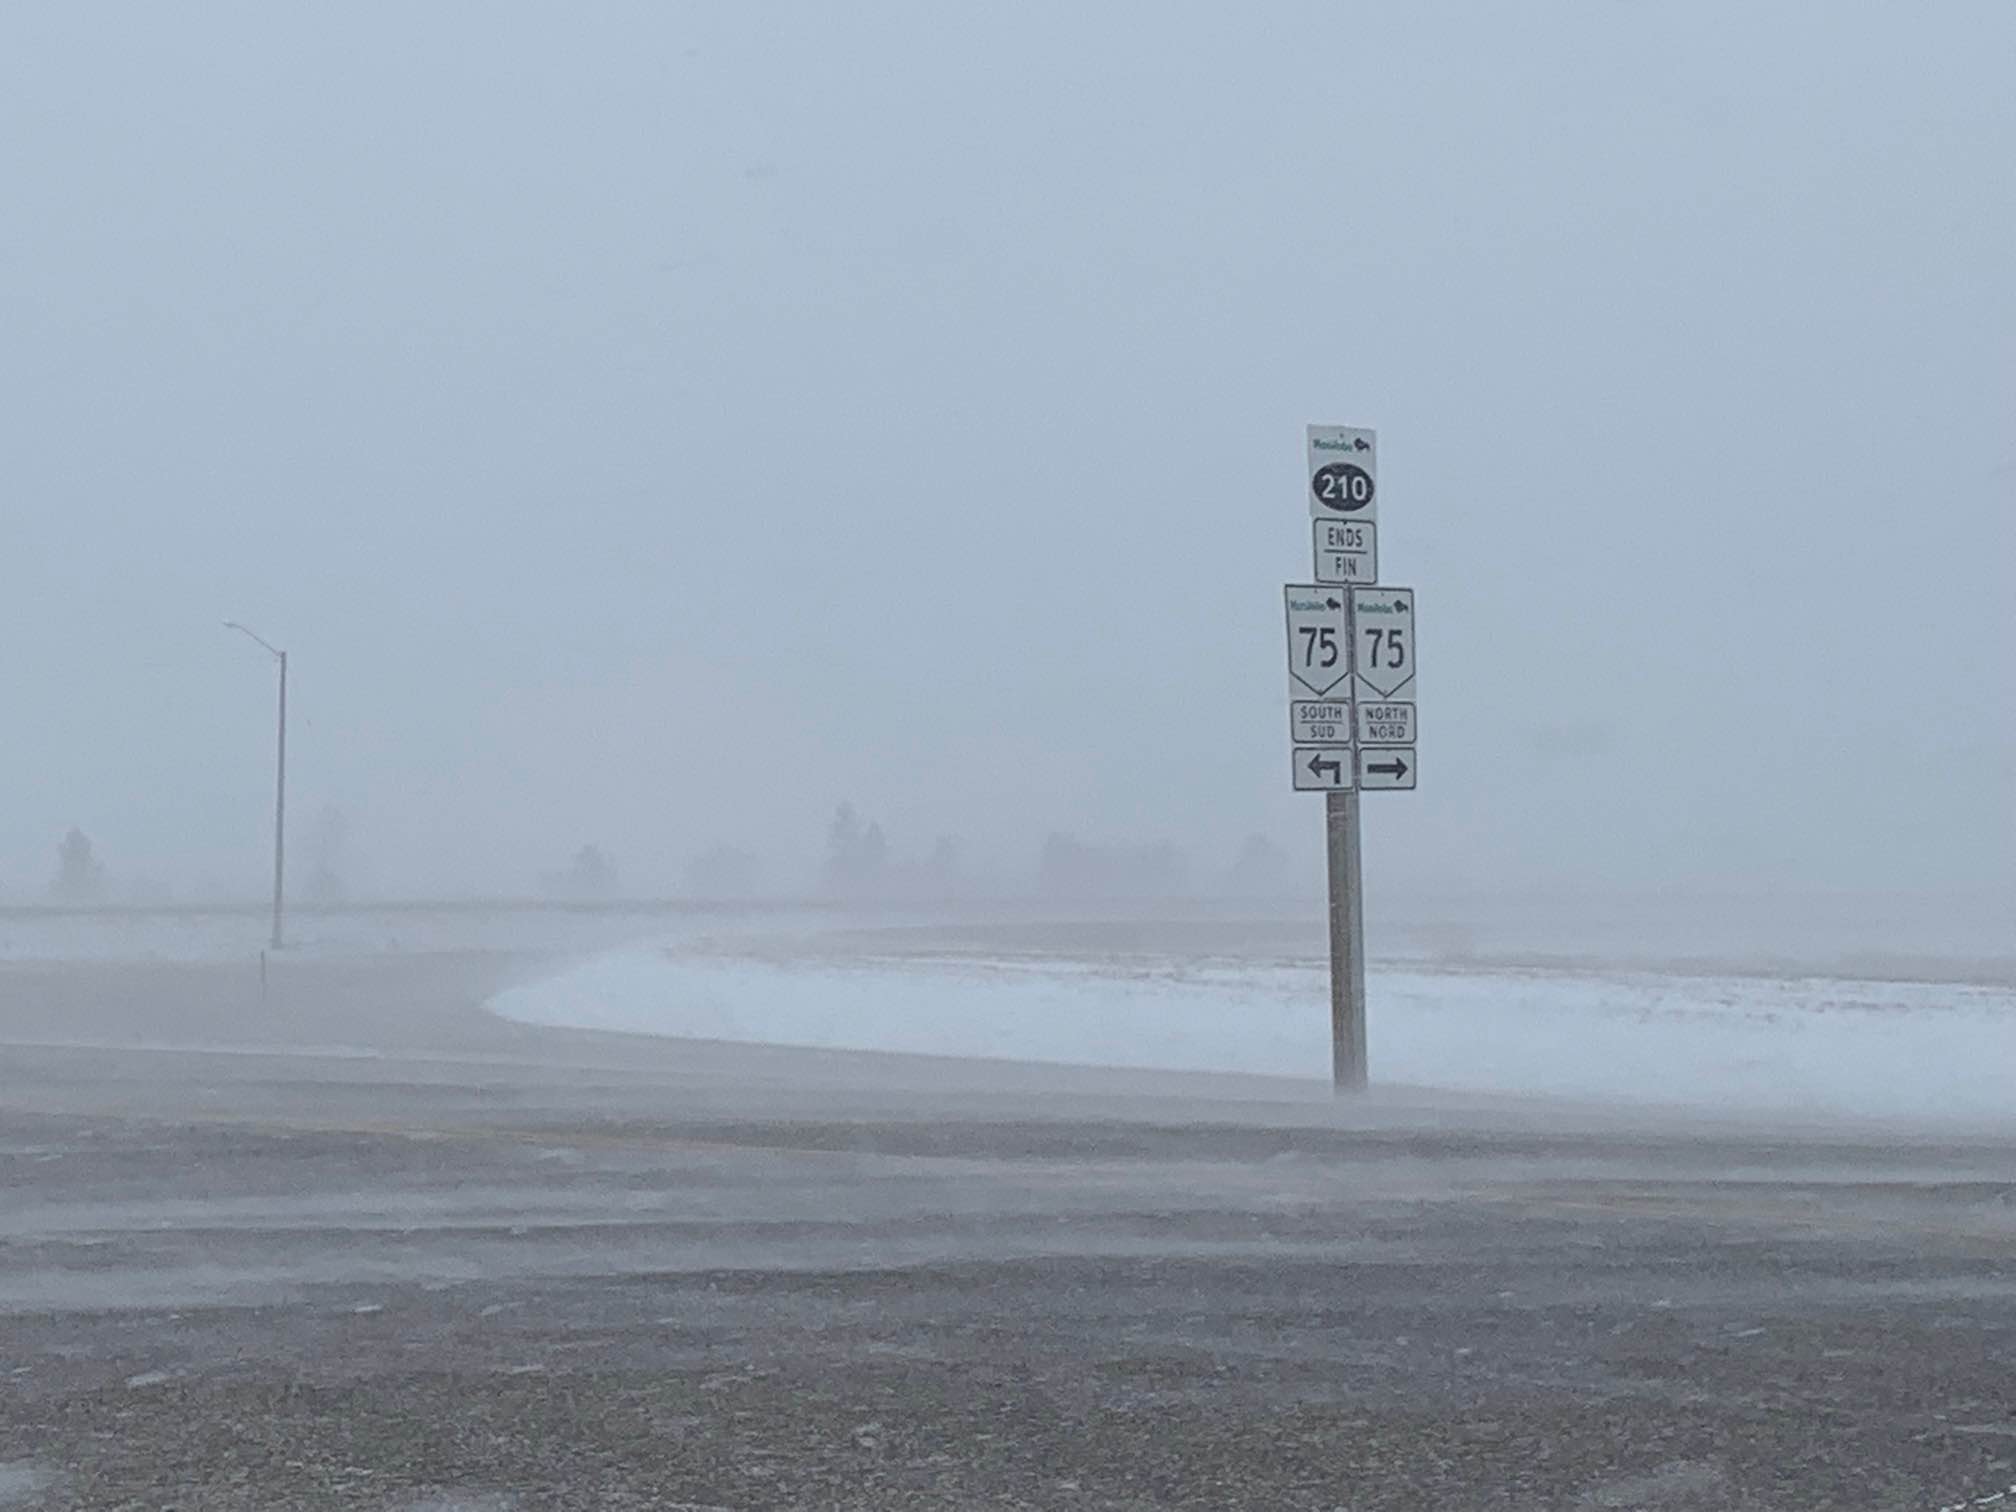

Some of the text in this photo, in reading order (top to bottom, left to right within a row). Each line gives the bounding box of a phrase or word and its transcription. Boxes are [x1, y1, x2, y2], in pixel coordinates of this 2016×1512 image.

[1321, 473, 1367, 500] 210
[1328, 527, 1362, 547] ENDS
[1335, 556, 1357, 576] FIN
[1299, 627, 1338, 668] 75
[1365, 629, 1404, 669] 75
[1300, 705, 1342, 719] SOUTH
[1366, 707, 1408, 720] NORTH
[1310, 725, 1335, 738] SUD
[1369, 725, 1405, 738] NORD
